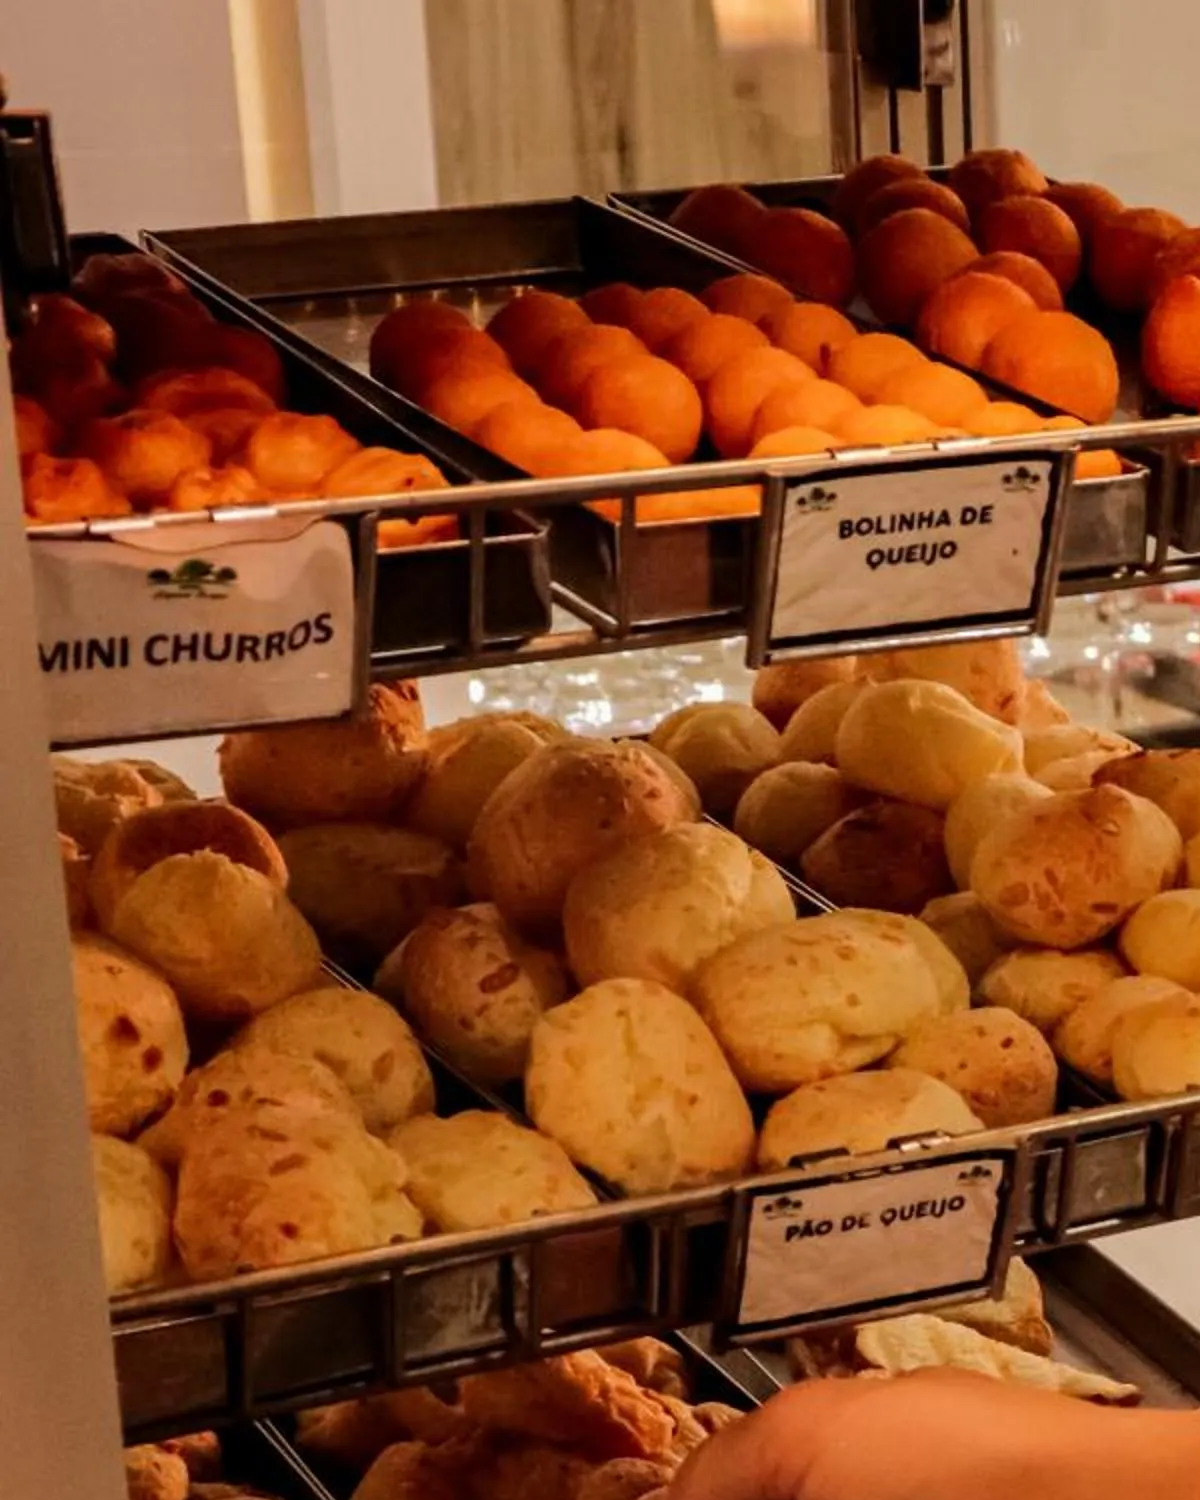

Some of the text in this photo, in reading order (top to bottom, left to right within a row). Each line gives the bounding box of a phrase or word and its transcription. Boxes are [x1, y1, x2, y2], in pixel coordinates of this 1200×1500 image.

[838, 504, 995, 540] BOLINHA DE
[865, 540, 959, 570] QUEIJO
[38, 612, 335, 673] MINI CHURROS
[785, 1195, 966, 1242] PÃO DE QUEIJO
